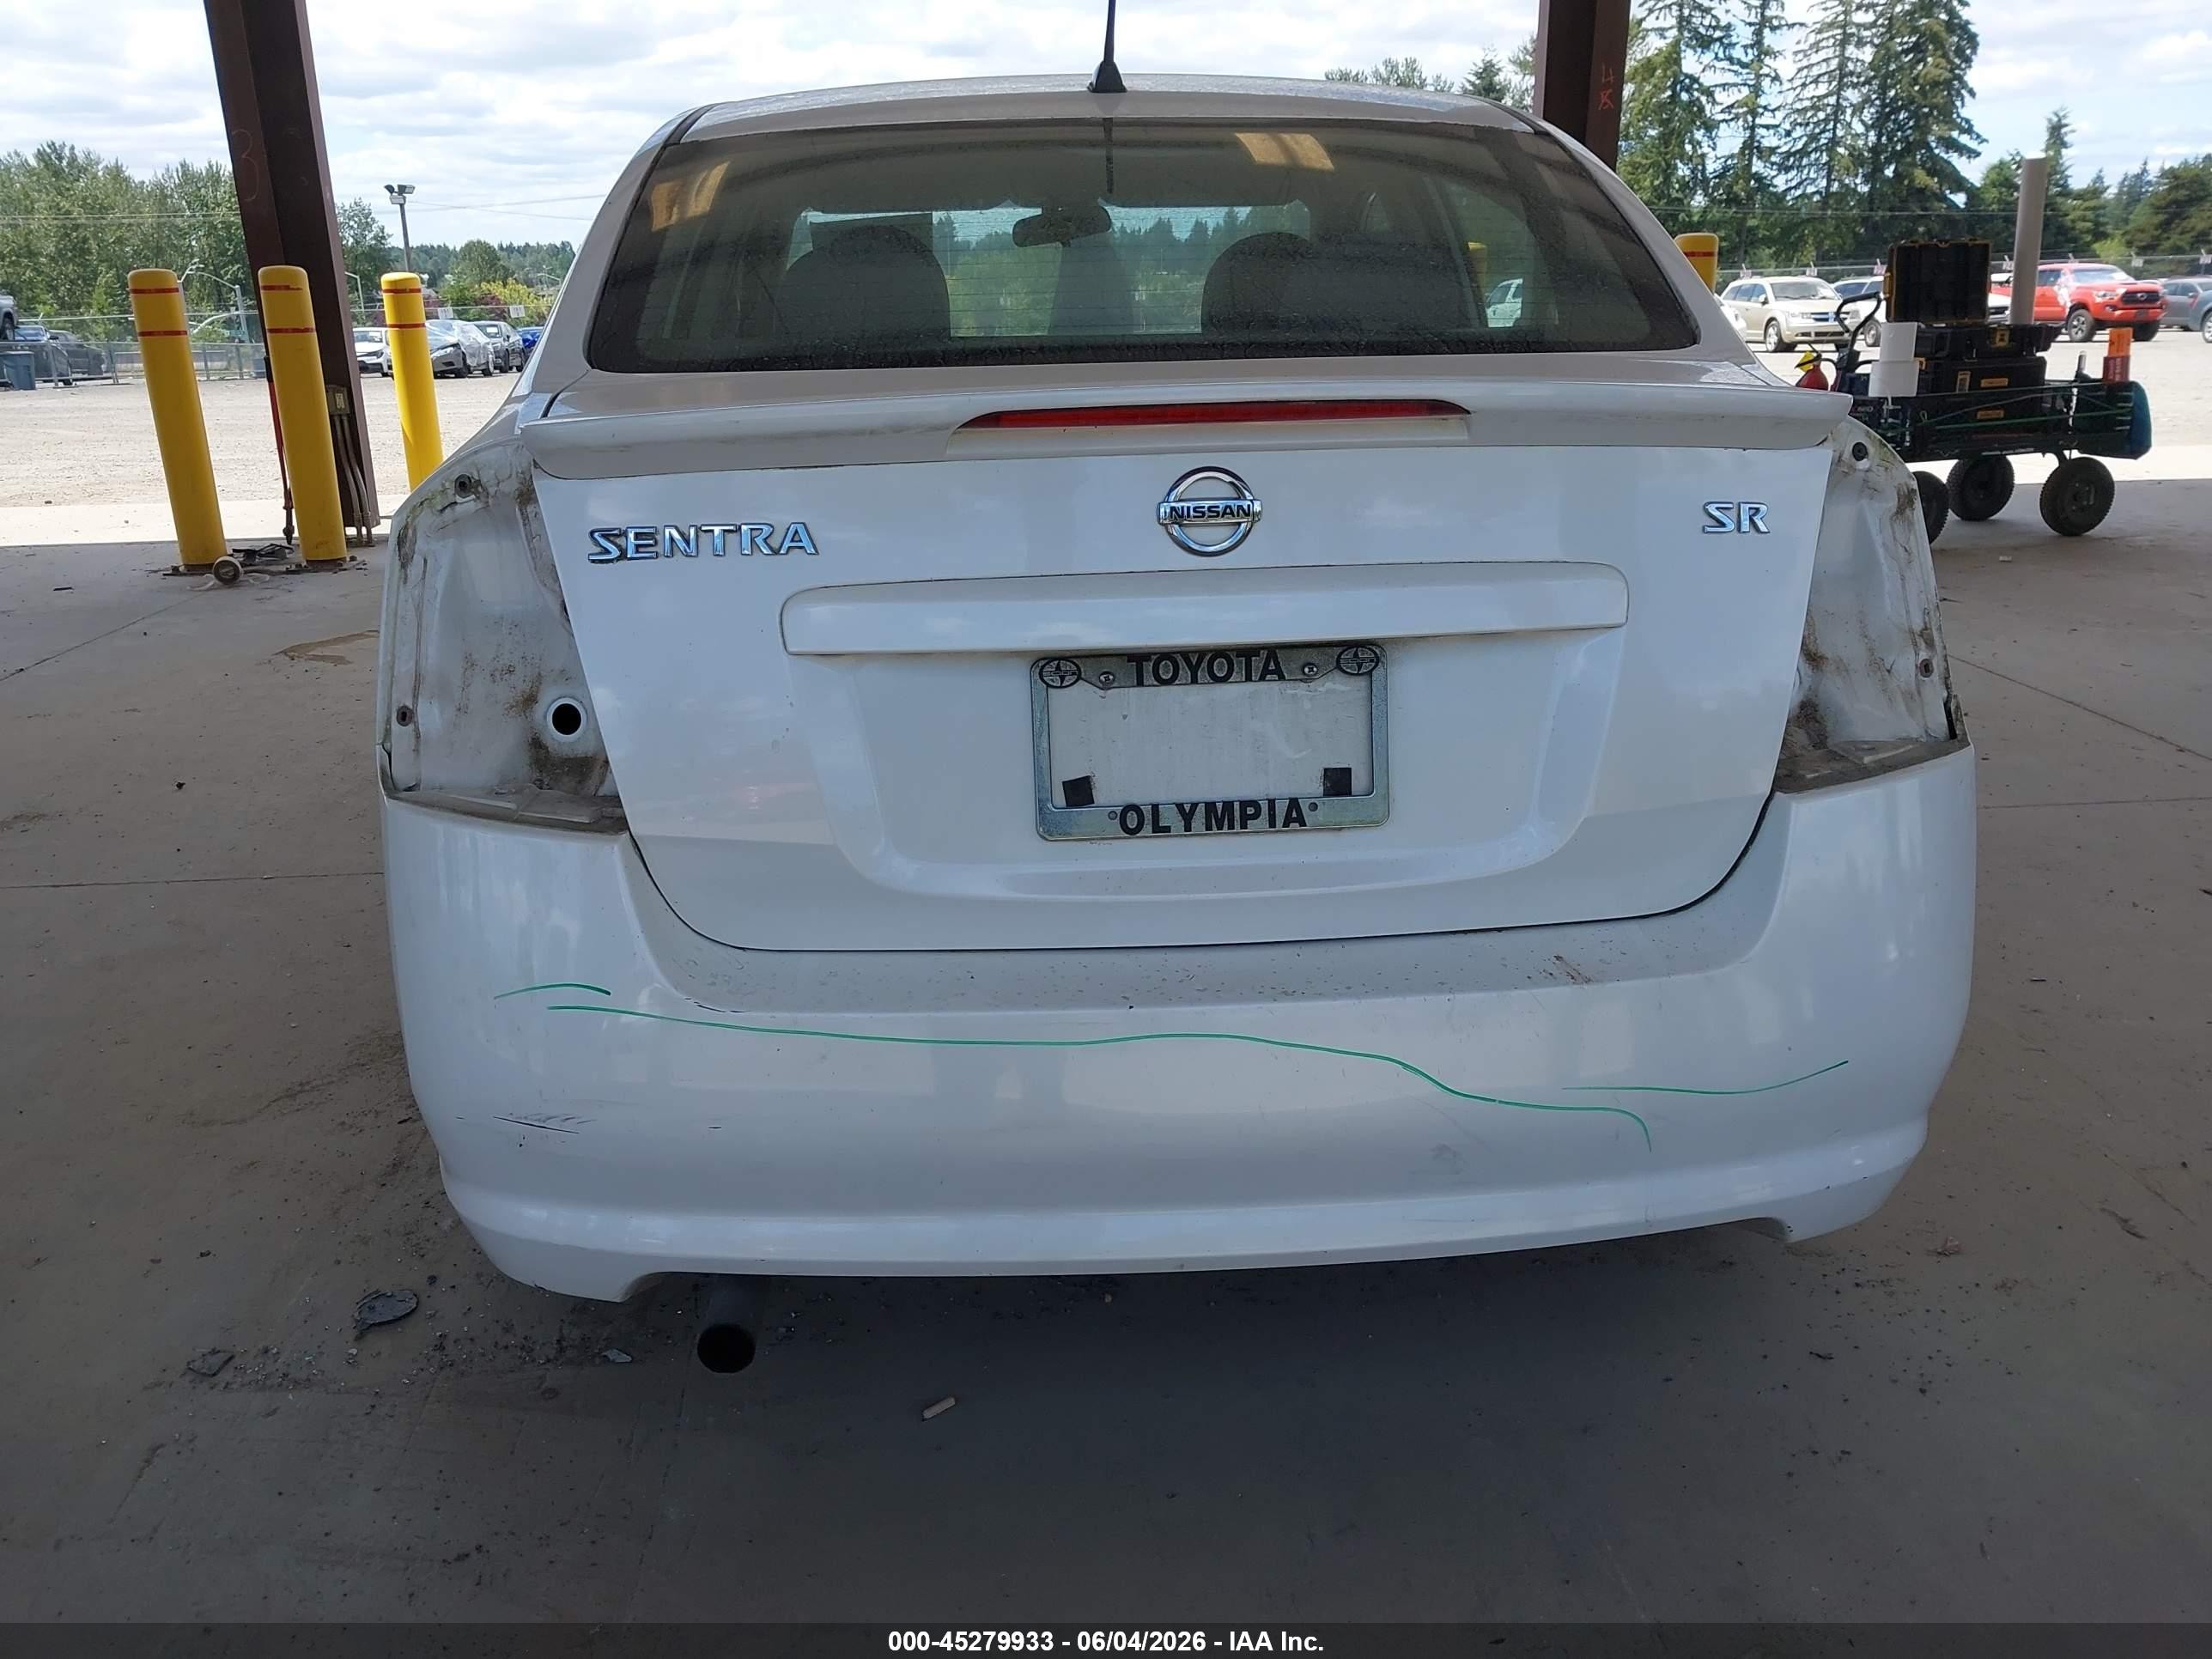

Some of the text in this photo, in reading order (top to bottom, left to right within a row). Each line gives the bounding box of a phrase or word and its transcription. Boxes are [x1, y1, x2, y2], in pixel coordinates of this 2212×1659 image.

[1170, 504, 1251, 520] NISSAN
[1703, 501, 1771, 534] SR
[588, 522, 818, 562] SENTRA
[1127, 649, 1286, 685] TOYOTA
[1119, 798, 1308, 835] OLYMPIA
